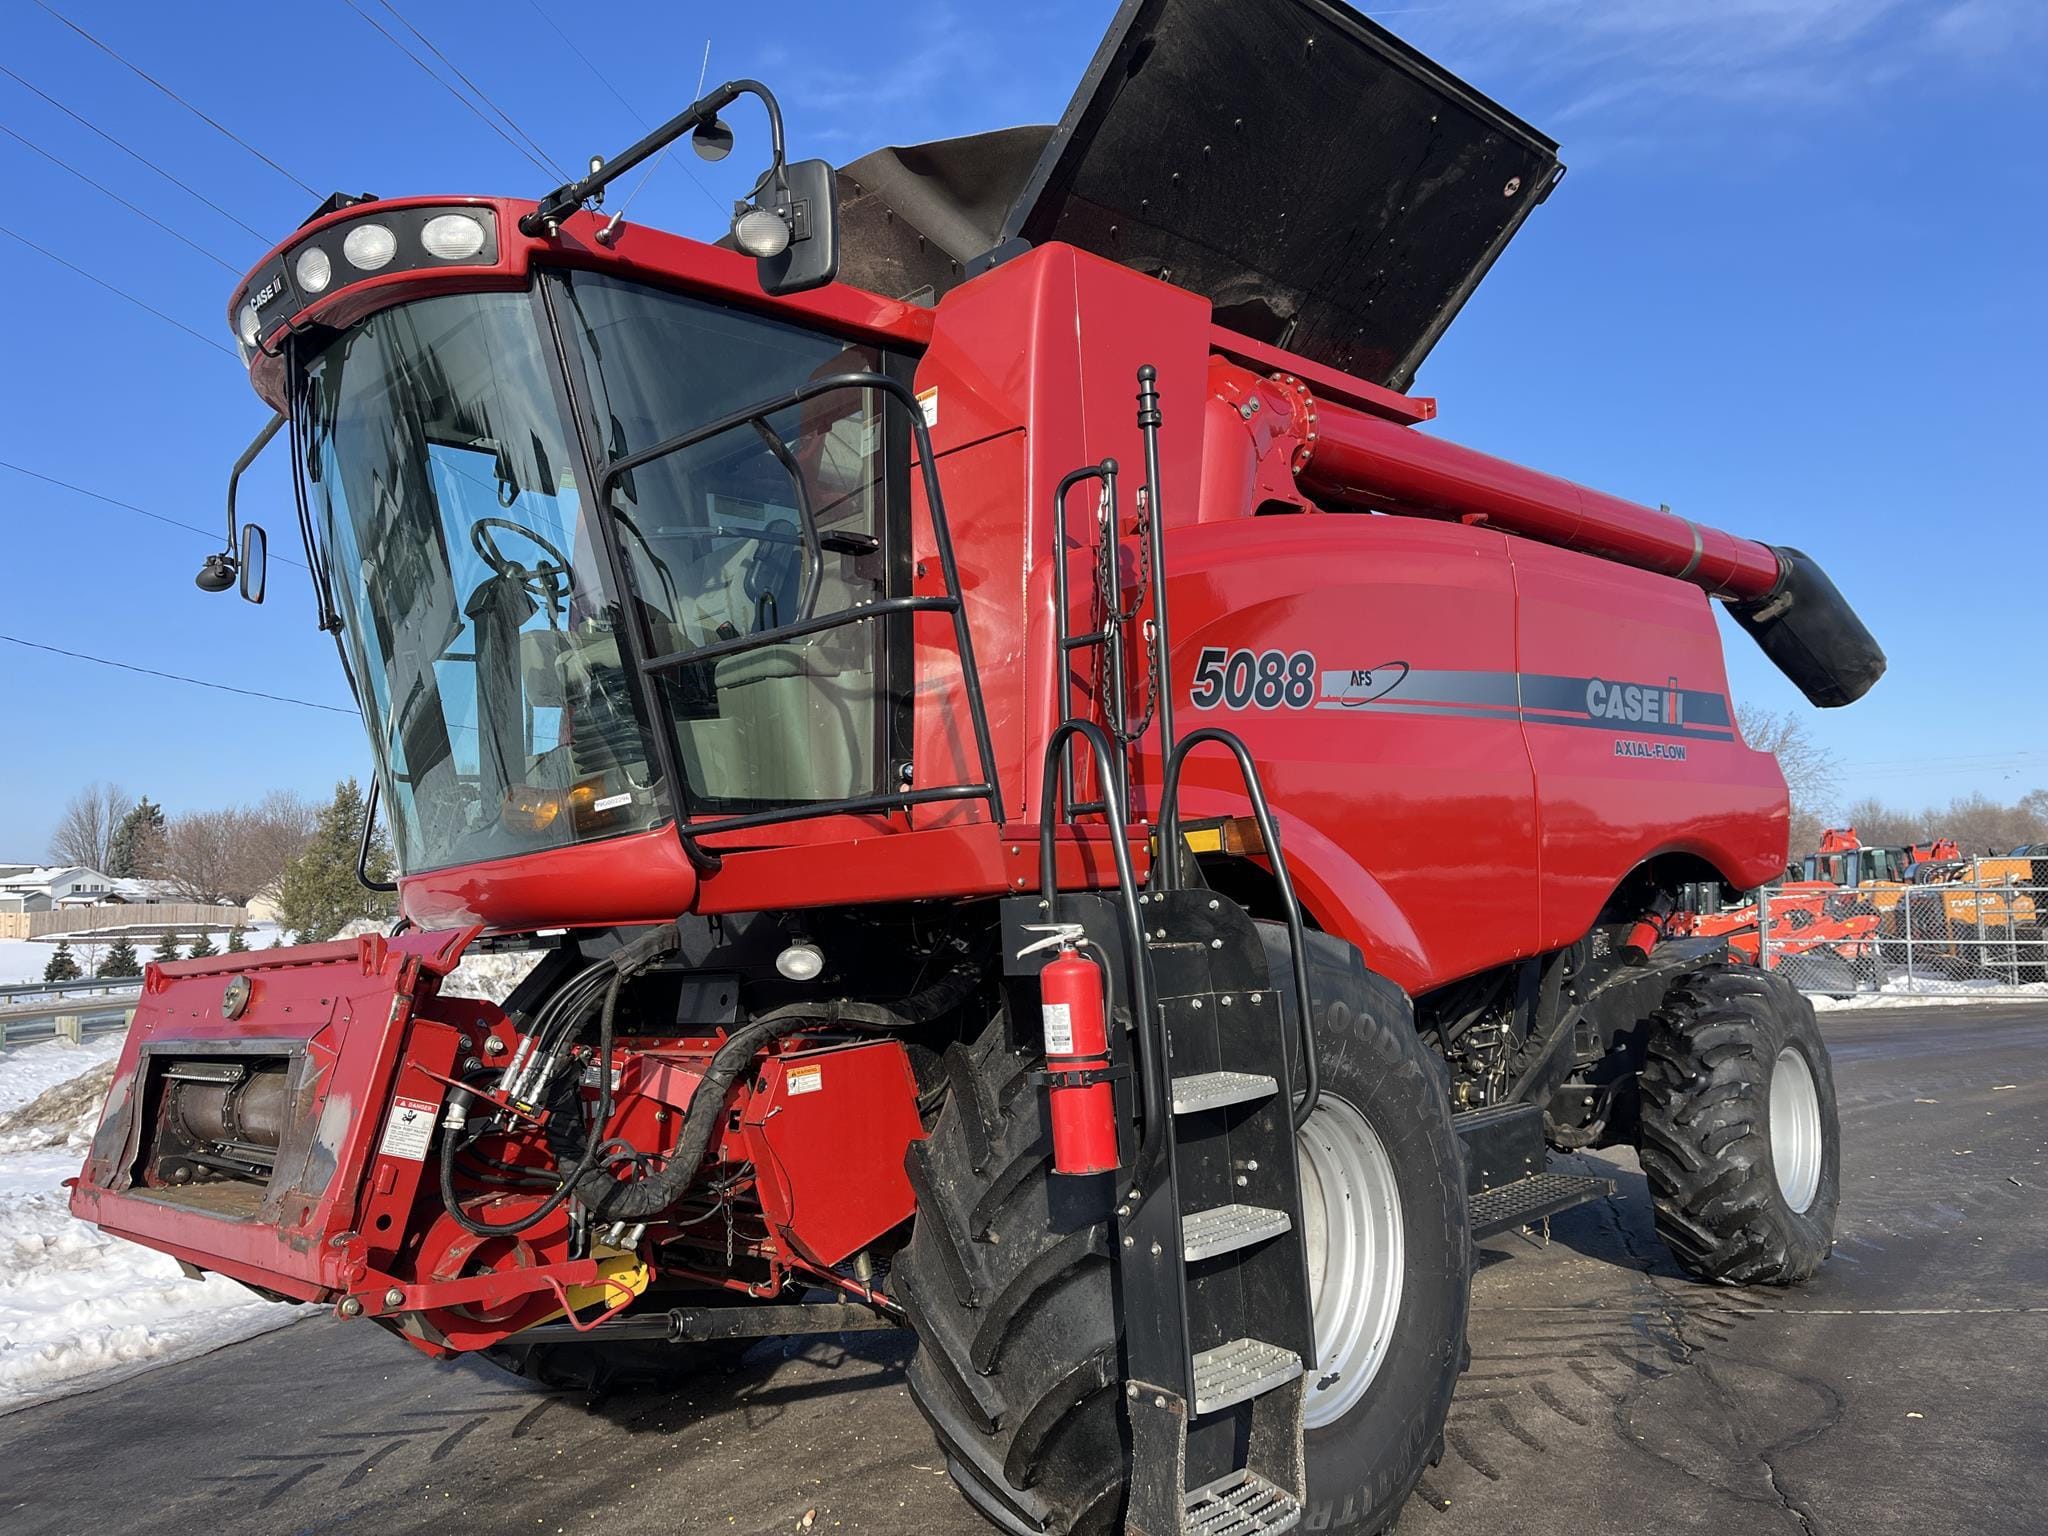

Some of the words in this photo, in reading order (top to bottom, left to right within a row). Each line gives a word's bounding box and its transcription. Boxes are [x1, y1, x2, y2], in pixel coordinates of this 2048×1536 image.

[250, 285, 274, 312] CASE
[1190, 646, 1316, 711] 5088
[1350, 670, 1372, 686] AFS
[1586, 679, 1659, 723] CASE
[1614, 739, 1687, 761] AXIAL-FLOW
[407, 1102, 432, 1111] DANGER
